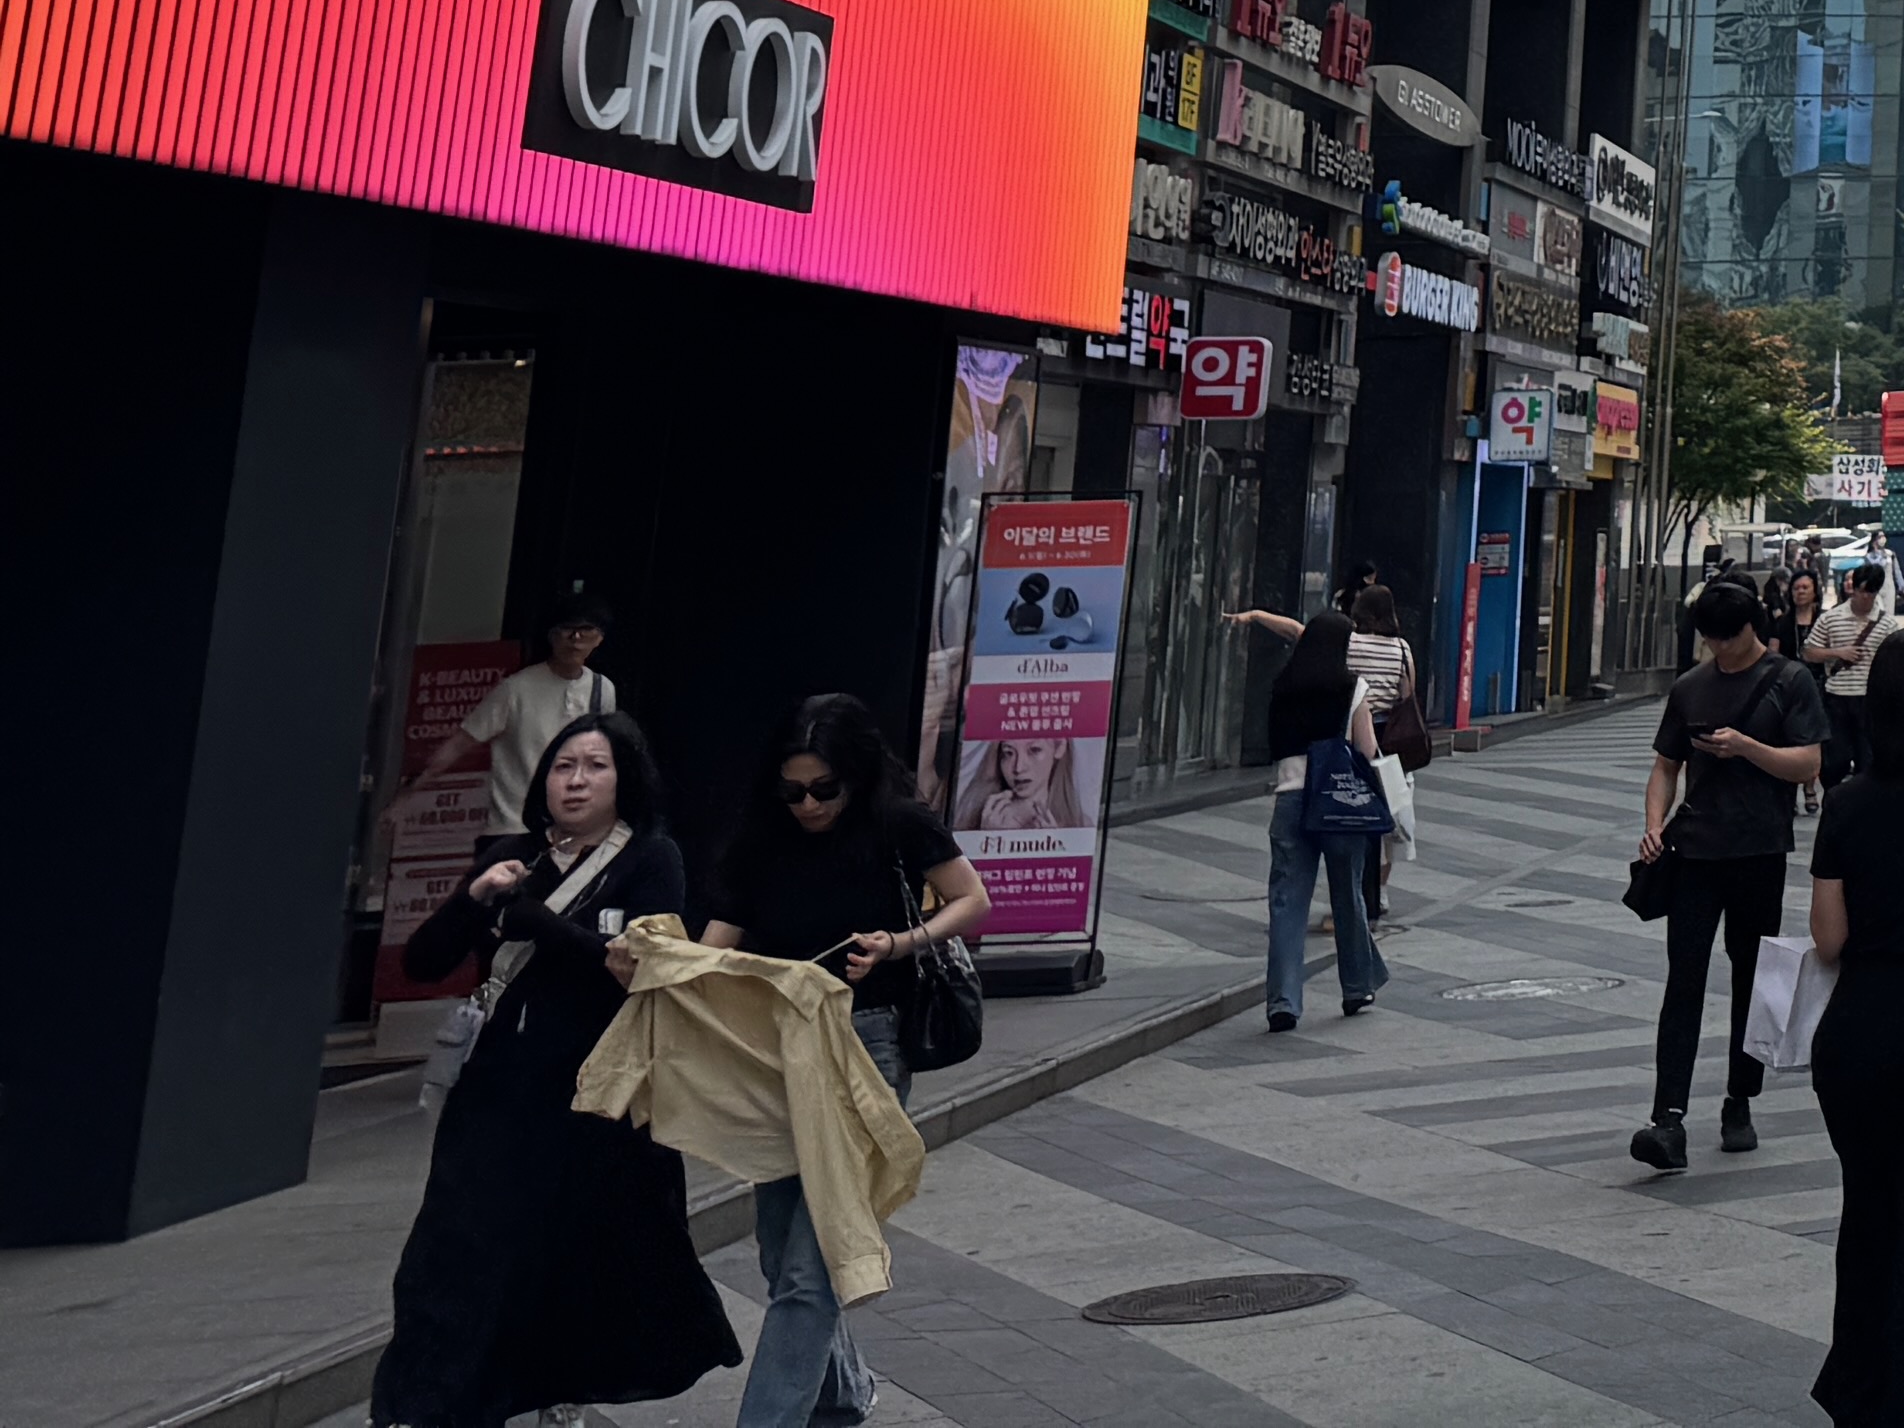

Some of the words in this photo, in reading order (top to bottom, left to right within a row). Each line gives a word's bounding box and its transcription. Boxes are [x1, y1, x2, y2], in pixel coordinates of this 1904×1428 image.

[1402, 264, 1451, 325] BURGER
[1450, 279, 1480, 332] KING
[1191, 345, 1258, 412] 약
[1501, 396, 1543, 446] 약
[1837, 456, 1887, 476] 삼성회
[1003, 525, 1055, 546] 이달의
[1058, 524, 1111, 545] 브랜드
[1017, 658, 1069, 675] d'Alba
